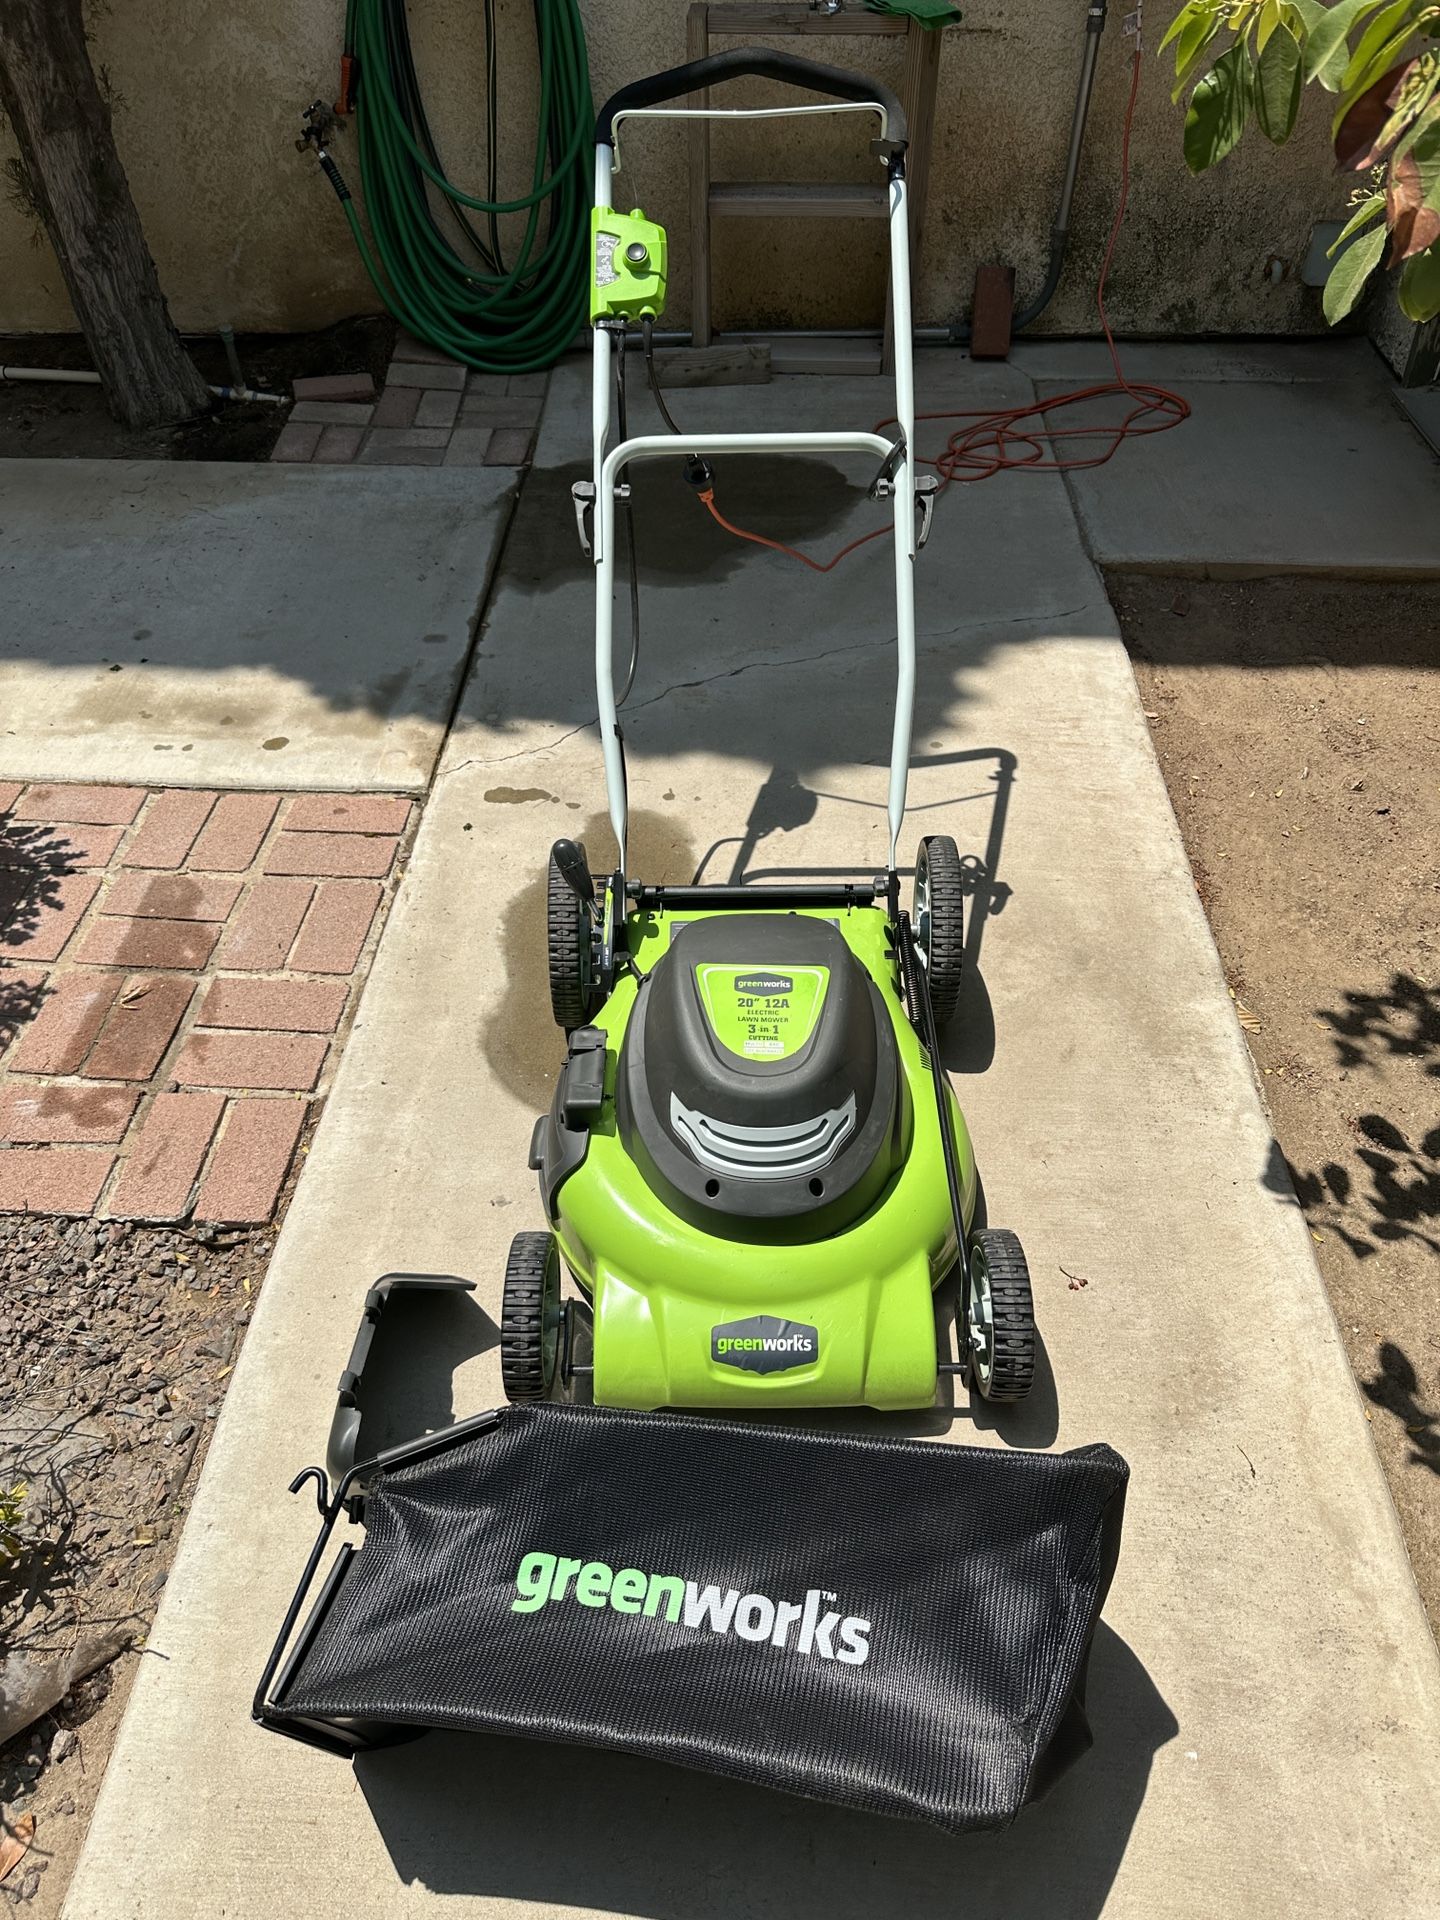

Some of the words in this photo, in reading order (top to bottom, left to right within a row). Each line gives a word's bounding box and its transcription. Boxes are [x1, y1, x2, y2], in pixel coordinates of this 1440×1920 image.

[737, 979, 791, 989] greenworks
[765, 998, 790, 1009] 12A
[717, 1334, 812, 1354] greenworks
[511, 1551, 871, 1665] greenworks
